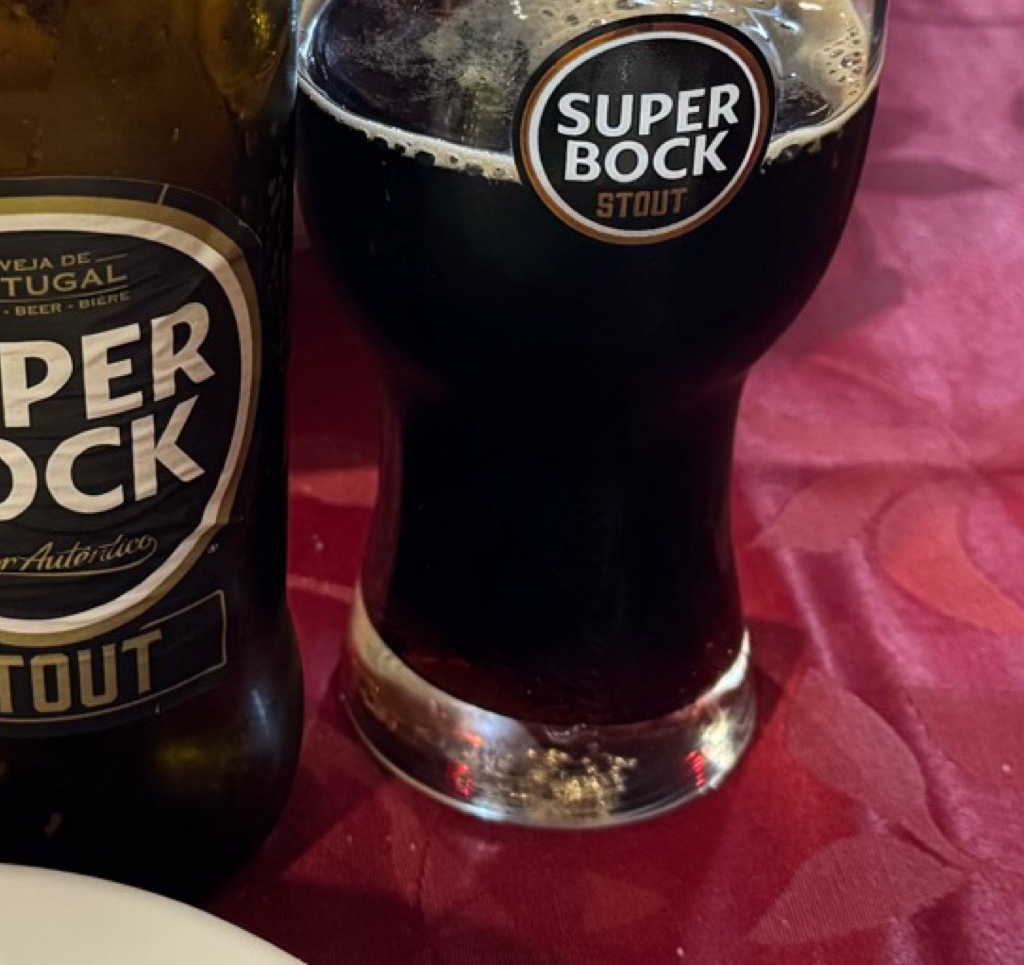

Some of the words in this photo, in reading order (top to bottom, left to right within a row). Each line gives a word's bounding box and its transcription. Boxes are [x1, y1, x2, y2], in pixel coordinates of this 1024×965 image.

[557, 83, 740, 137] SUPER
[564, 130, 729, 183] BOCK
[595, 188, 688, 218] STOUT
[60, 252, 92, 267] DE
[15, 302, 62, 316] BEER
